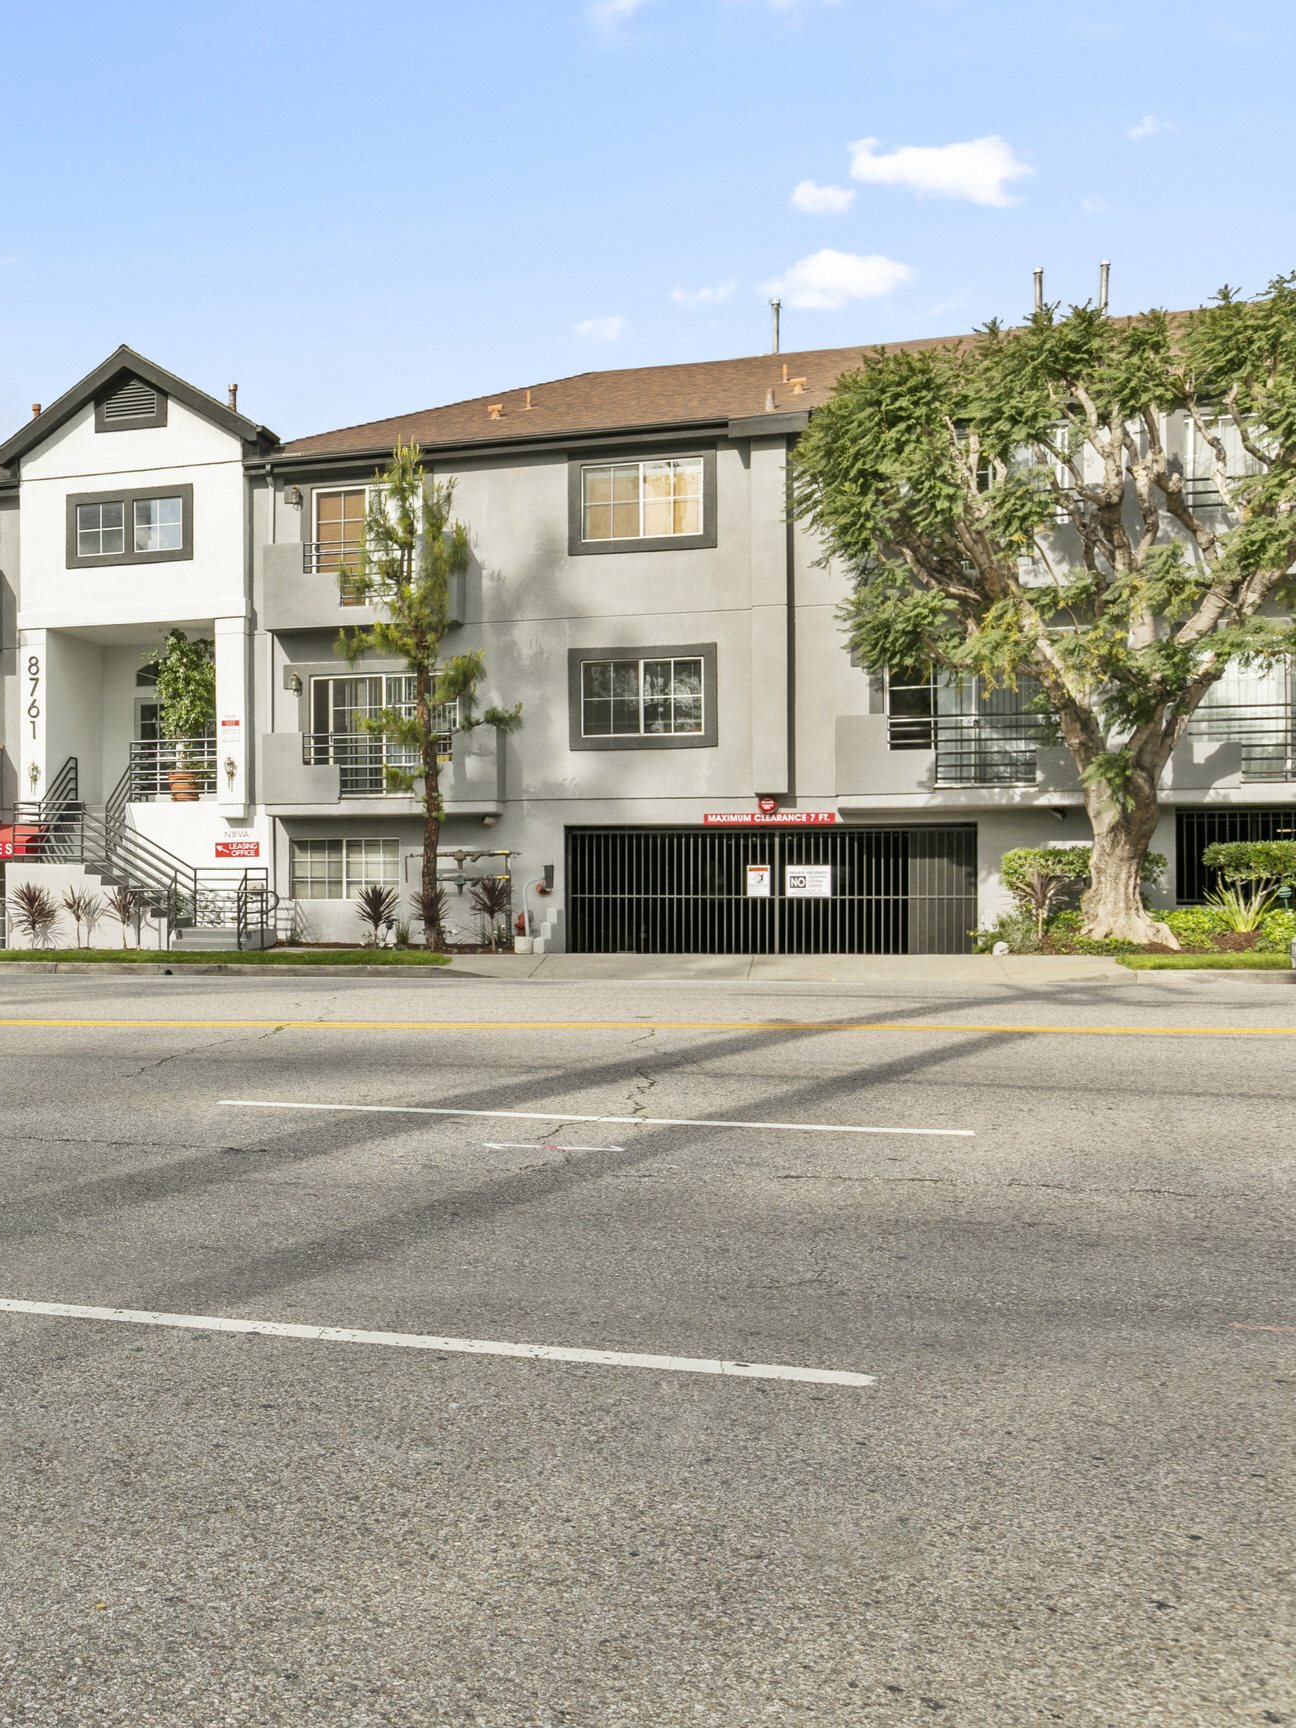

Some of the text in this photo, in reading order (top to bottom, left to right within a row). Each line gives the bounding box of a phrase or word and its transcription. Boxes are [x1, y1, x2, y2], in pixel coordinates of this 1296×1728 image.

[27, 655, 40, 740] 8761
[707, 814, 752, 822] MAXIMUM
[754, 813, 807, 822] CLEARANCE
[810, 813, 815, 821] 7
[229, 842, 258, 850] LEASING
[231, 849, 256, 857] OFFICE
[790, 876, 806, 888] NO
